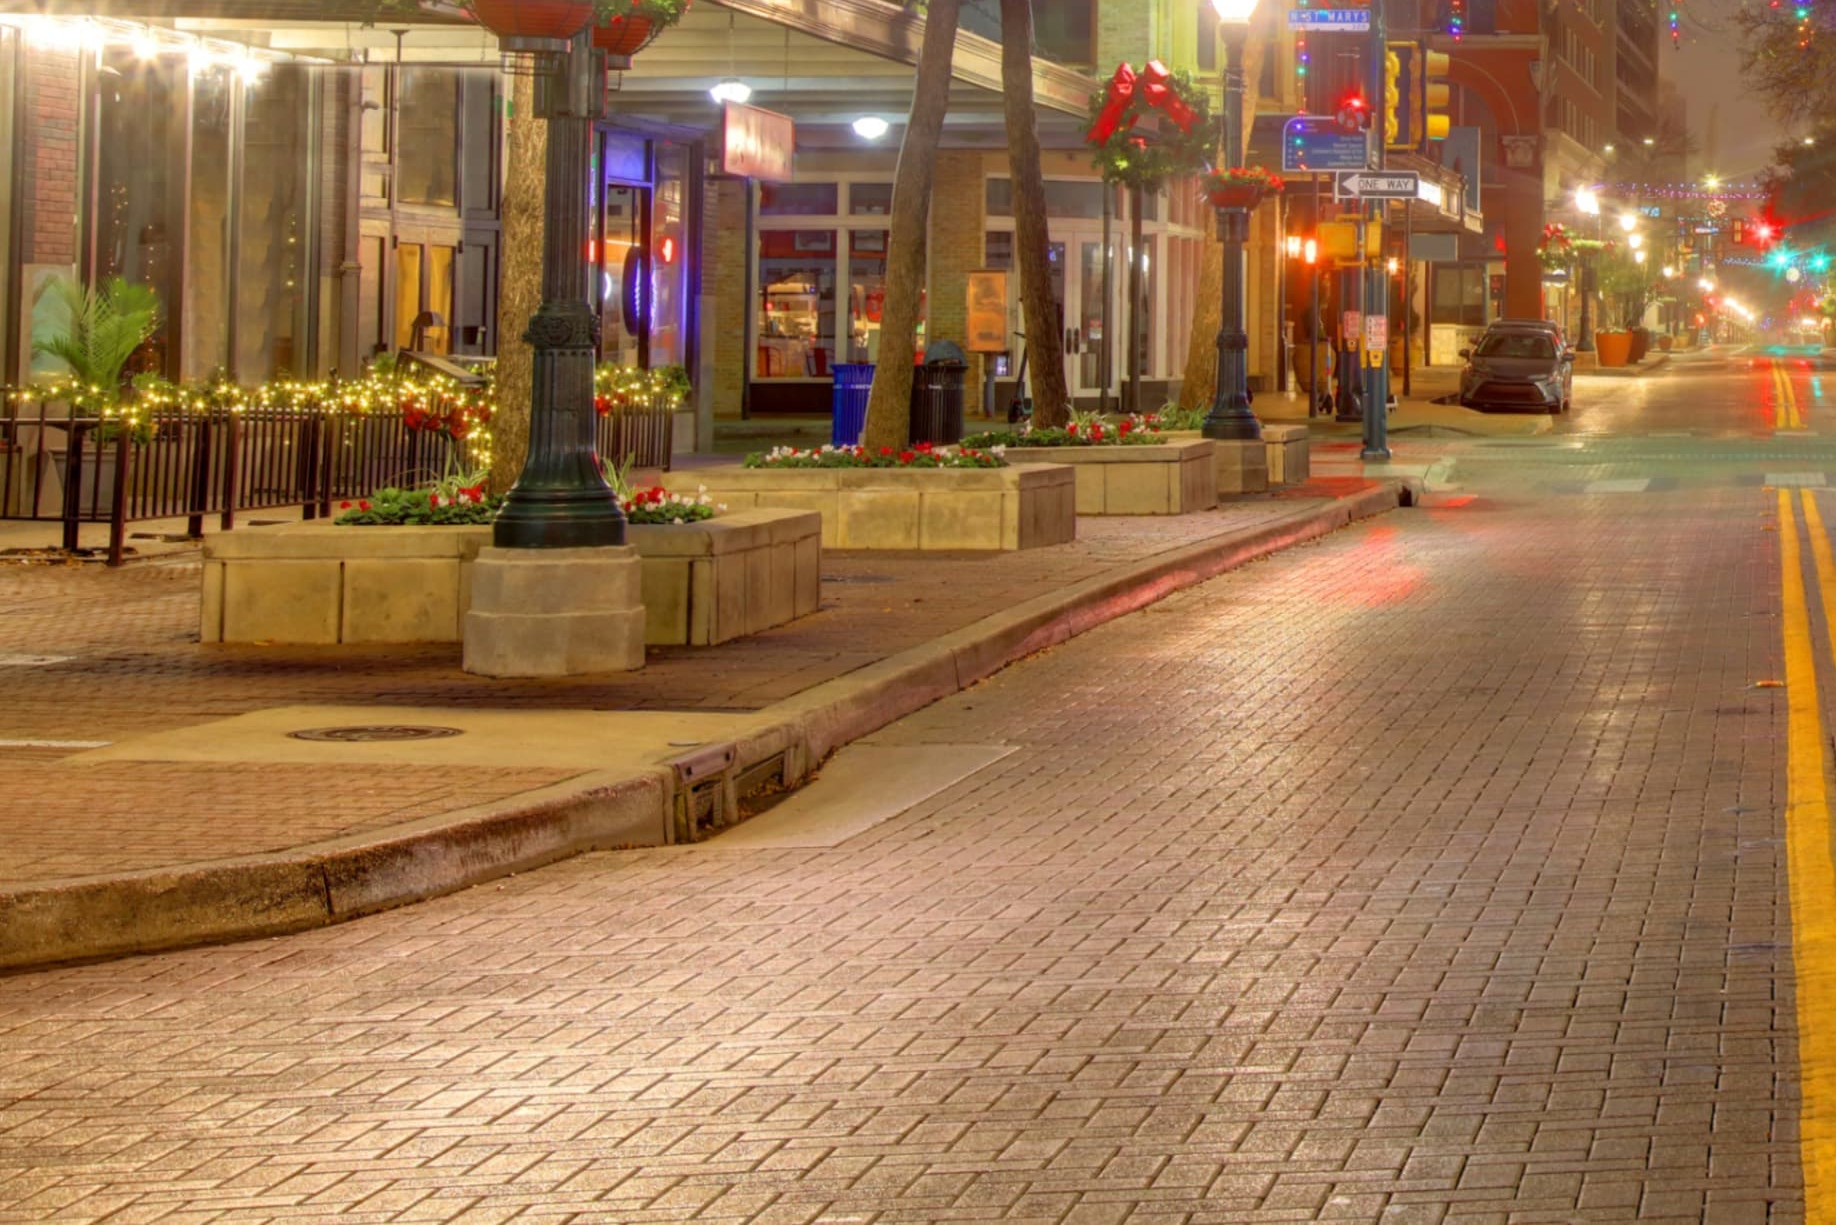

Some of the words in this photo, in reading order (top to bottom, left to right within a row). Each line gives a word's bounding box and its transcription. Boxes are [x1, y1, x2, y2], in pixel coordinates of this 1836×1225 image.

[1290, 11, 1297, 22] N
[1306, 11, 1320, 22] ST
[1328, 11, 1368, 22] MARYS
[1358, 179, 1378, 189] ONE
[1386, 178, 1410, 189] WAY
